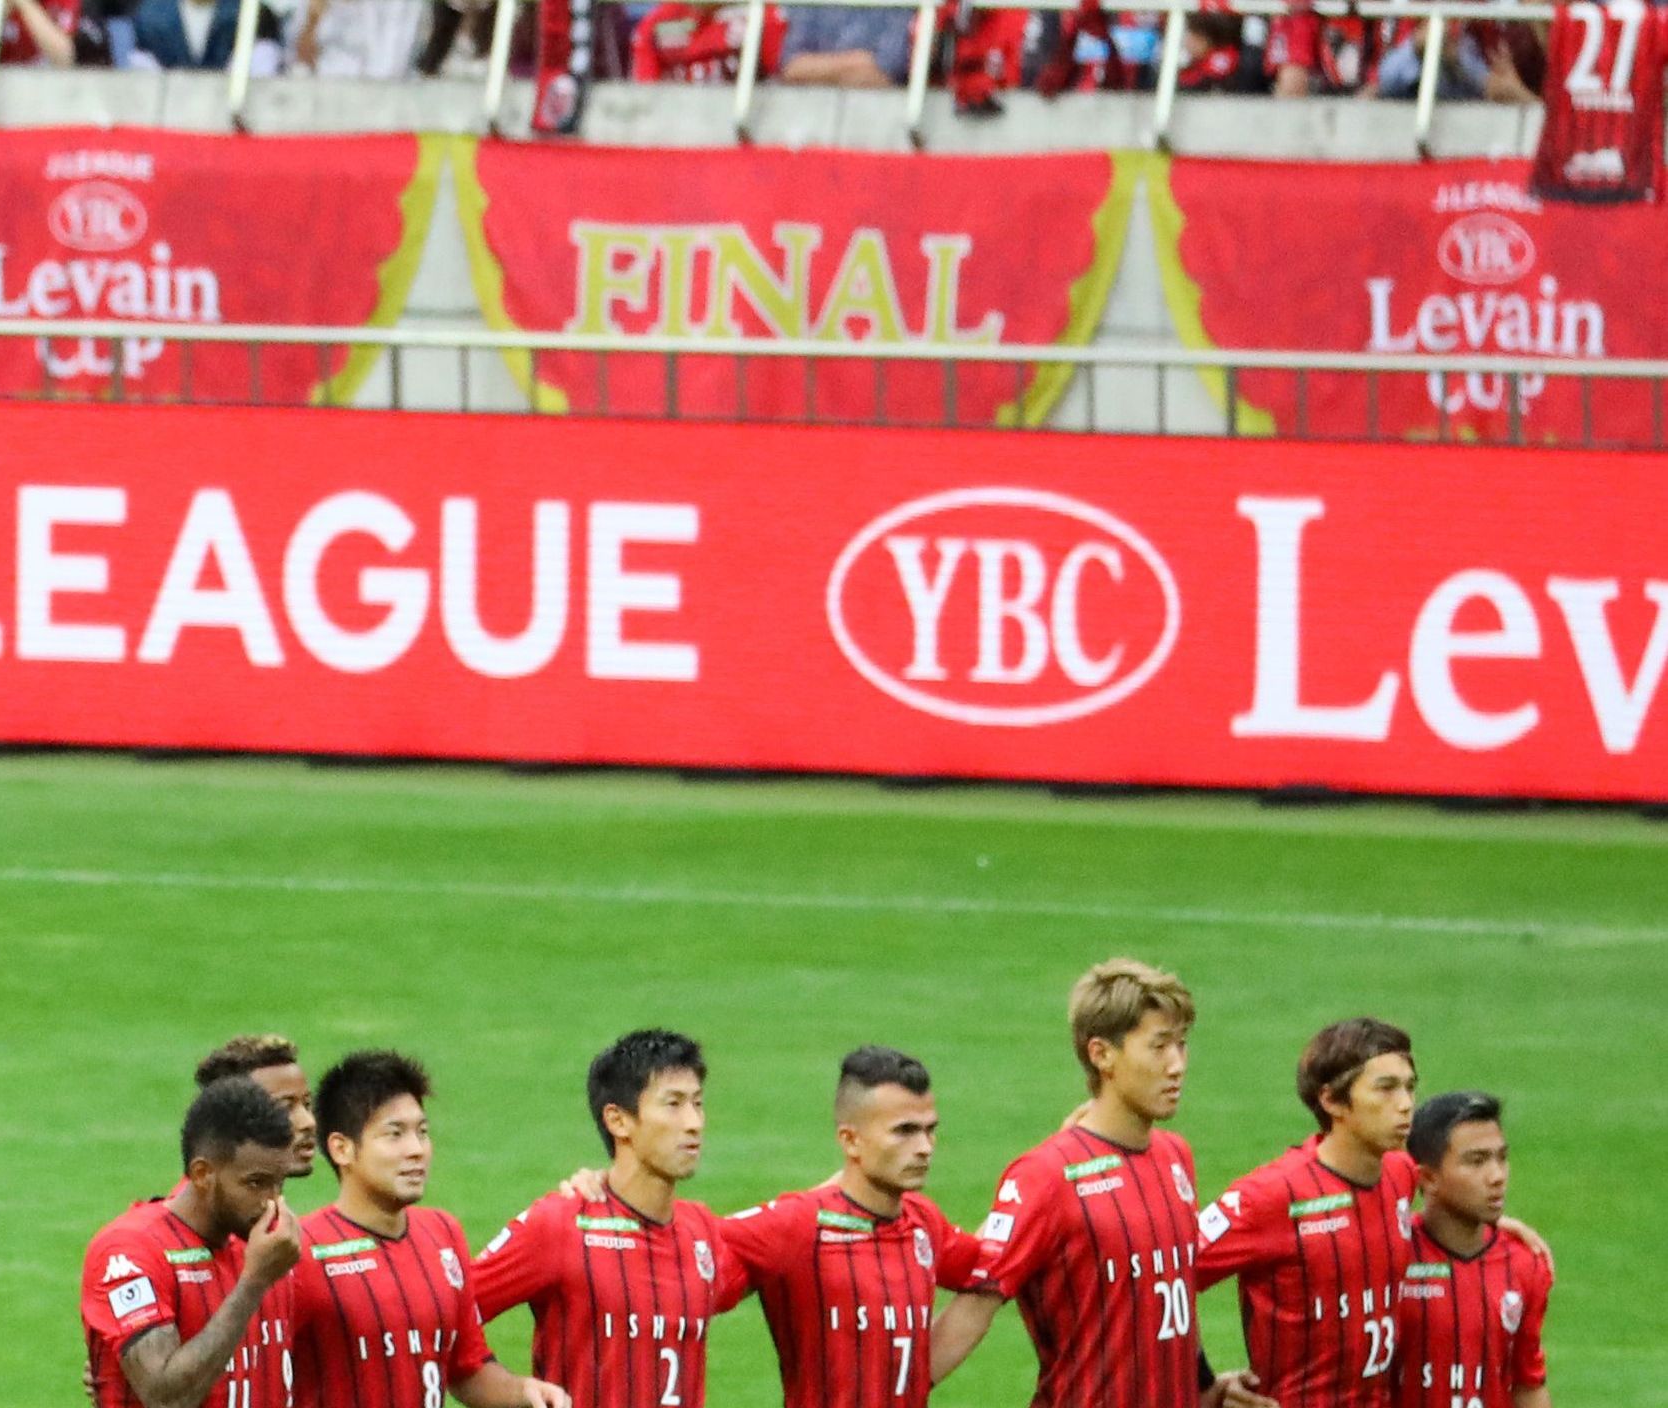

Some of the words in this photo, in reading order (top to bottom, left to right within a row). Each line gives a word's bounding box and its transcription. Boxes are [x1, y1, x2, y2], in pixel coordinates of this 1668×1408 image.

[1565, 1, 1646, 93] 27
[569, 219, 1006, 345] FINAL
[1366, 273, 1606, 359] Levain
[887, 536, 1126, 688] YBC
[1154, 1278, 1191, 1341] 20
[660, 1347, 681, 1406] 2
[893, 1337, 912, 1396] 7
[1363, 1316, 1395, 1378] 23
